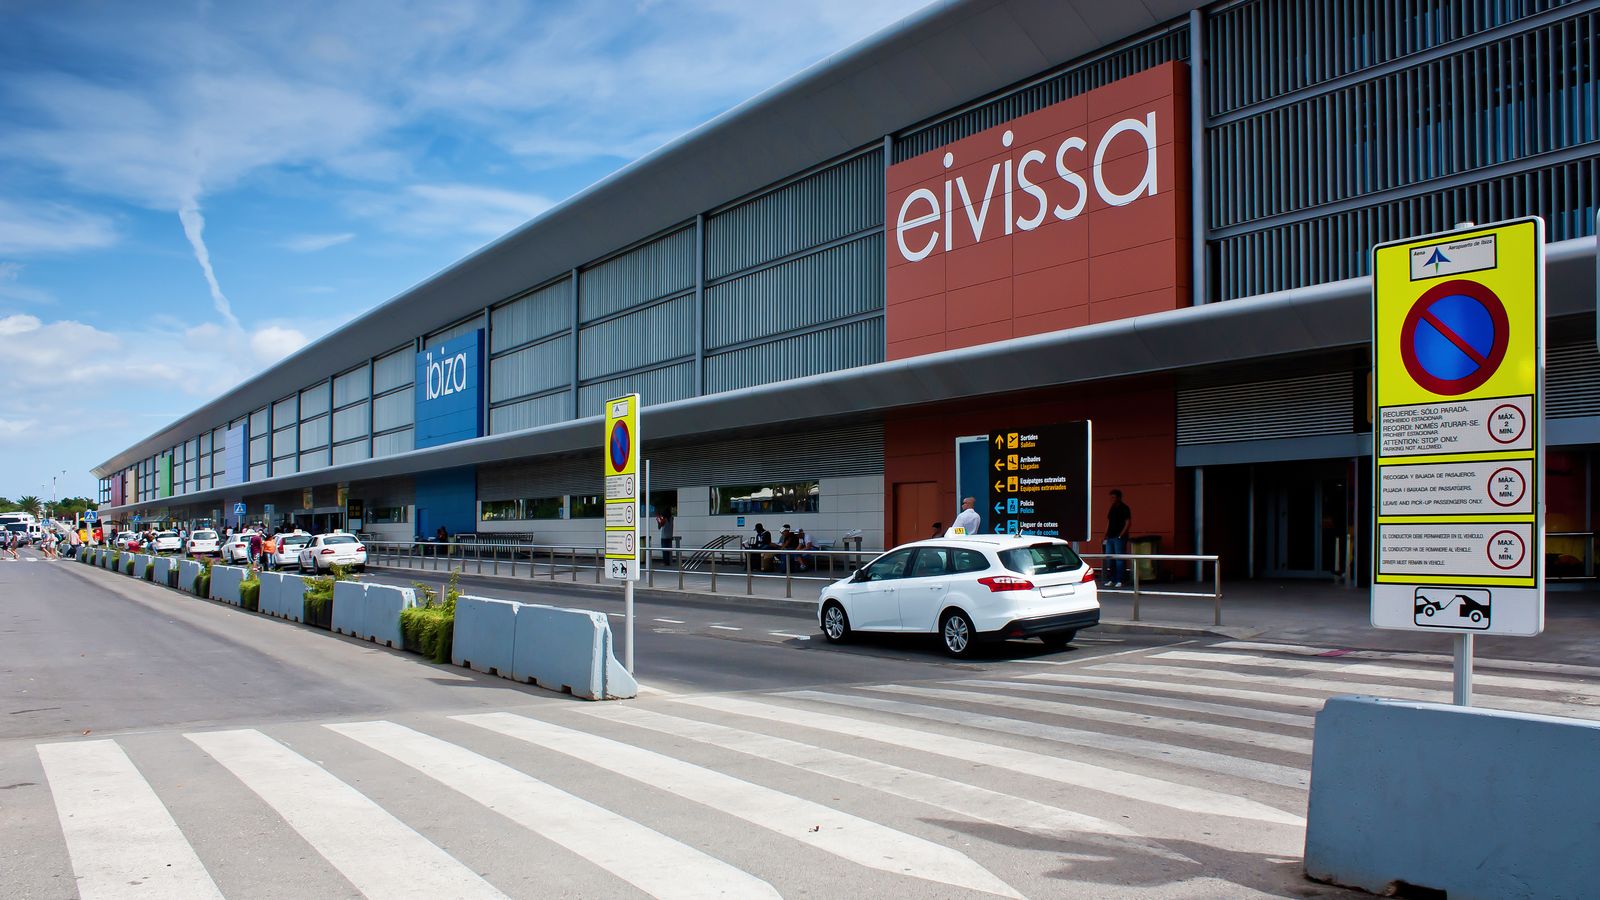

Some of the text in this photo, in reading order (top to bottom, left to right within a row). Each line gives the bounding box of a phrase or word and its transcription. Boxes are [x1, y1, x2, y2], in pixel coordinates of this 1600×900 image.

[896, 111, 1158, 262] eivissa
[426, 346, 466, 400] ibiza
[1383, 410, 1420, 418] RECUERDE:
[1440, 420, 1480, 428] ATURAR-SE.
